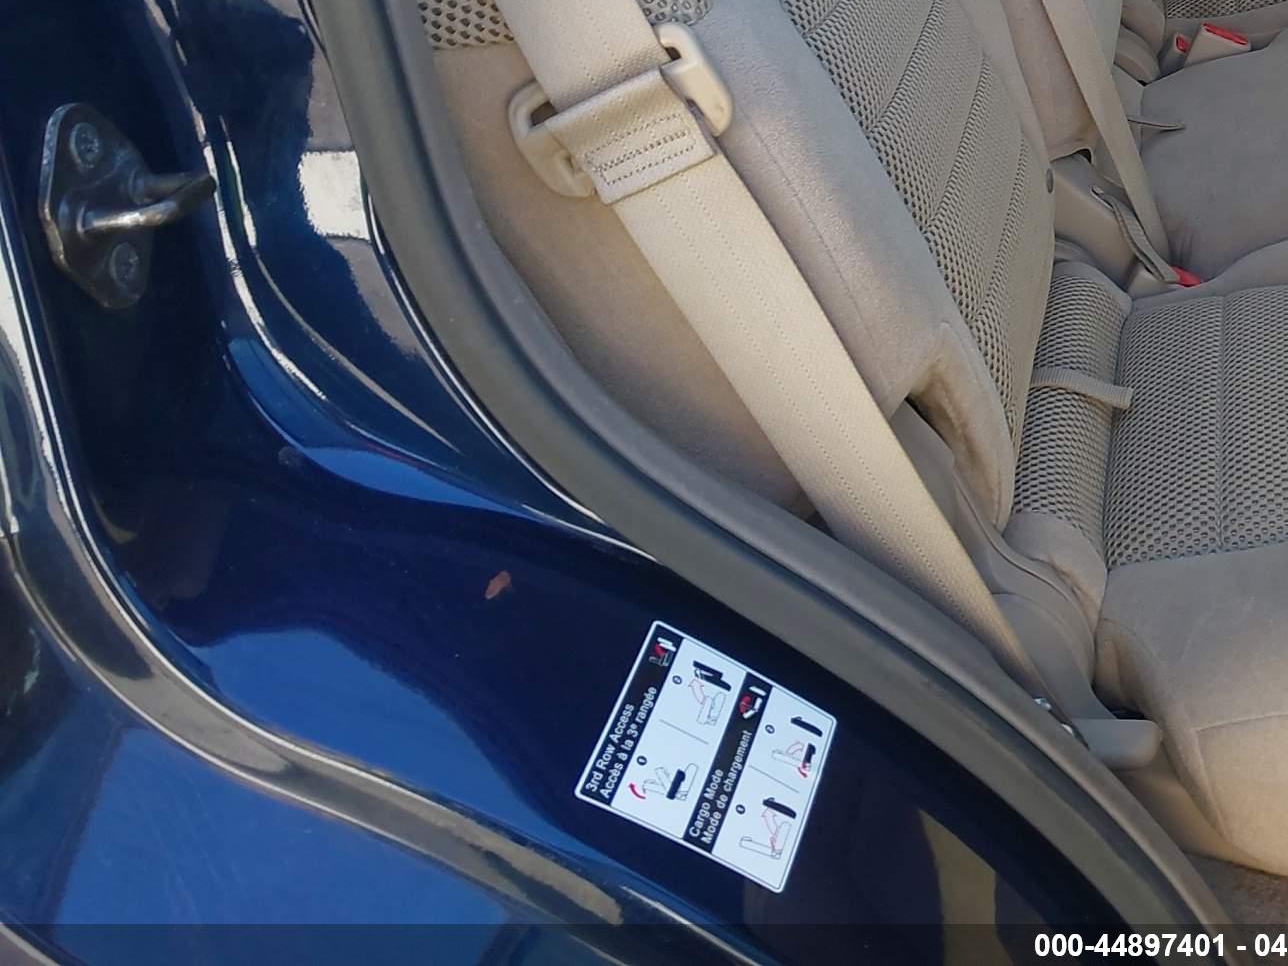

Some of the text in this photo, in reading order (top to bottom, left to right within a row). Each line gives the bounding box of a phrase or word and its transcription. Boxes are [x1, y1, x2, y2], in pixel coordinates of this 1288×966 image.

[585, 703, 635, 792] 3rd Row Access
[599, 762, 624, 799] Accès
[620, 739, 635, 751] la
[635, 686, 658, 723] rangée
[700, 730, 753, 844] Mode de chargement
[689, 768, 724, 837] Cargo Mode
